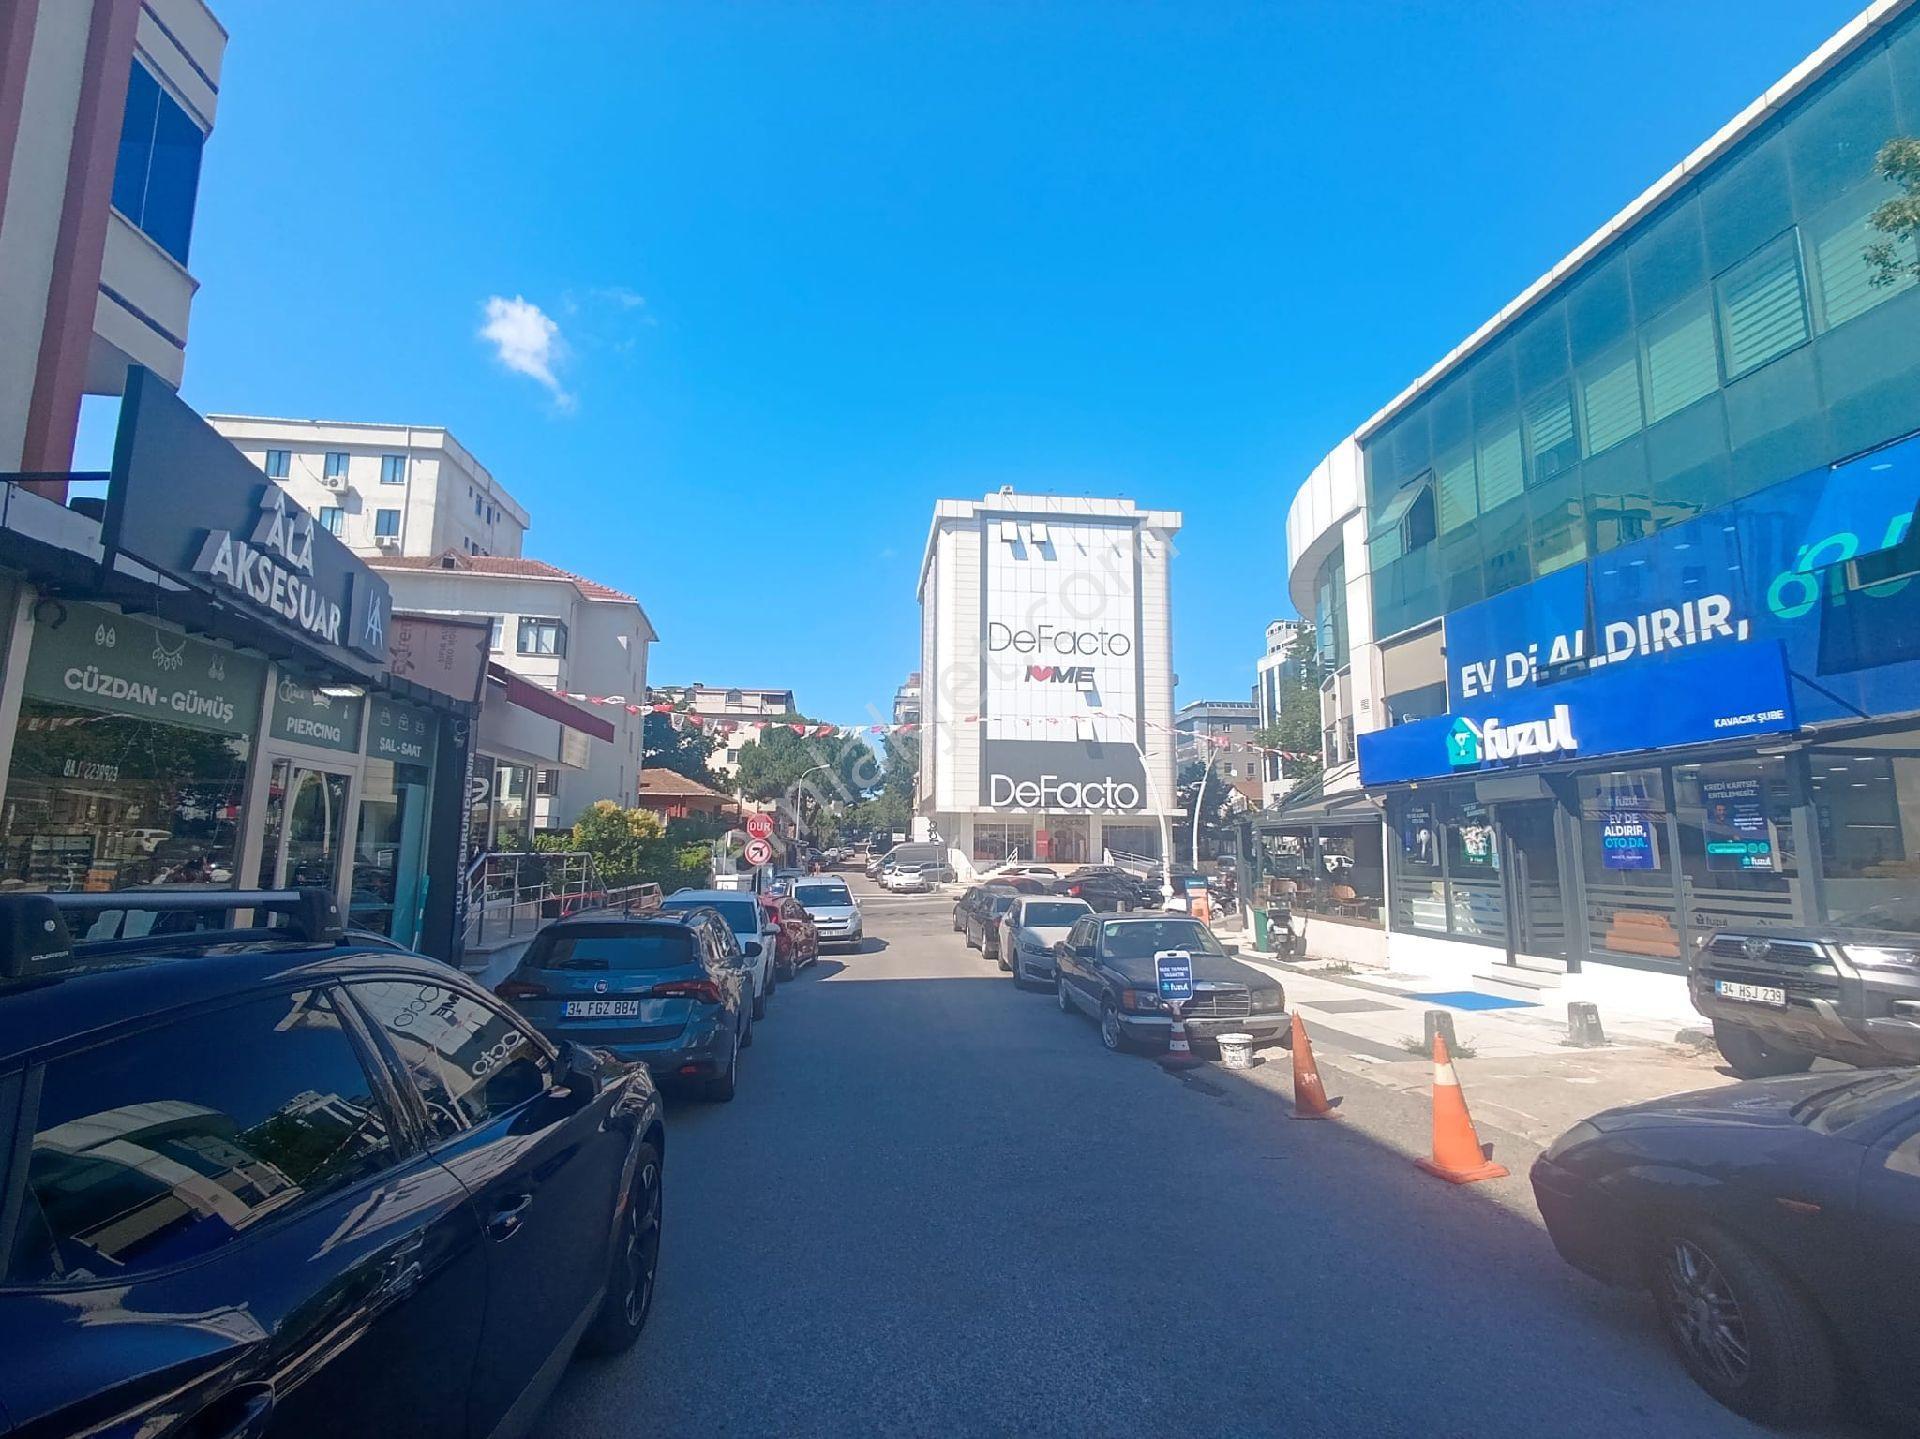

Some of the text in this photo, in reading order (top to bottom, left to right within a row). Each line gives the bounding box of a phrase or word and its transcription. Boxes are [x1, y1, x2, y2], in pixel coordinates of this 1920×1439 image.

[209, 530, 341, 646] AKSESUAR
[988, 622, 1131, 657] DeFacto
[64, 665, 158, 706] CÜZDAN
[171, 689, 234, 724] GÜMÜŞ
[1461, 658, 1496, 698] EV
[286, 716, 341, 743] PIERCING
[1480, 703, 1578, 760] fuzul
[1713, 709, 1785, 728] KAVACIK ŞUBE
[990, 773, 1139, 809] DeFacto
[749, 821, 771, 832] DUR
[568, 1001, 636, 1016] 34 FGZ 884
[1722, 983, 1782, 1002] 34 HSJ 239
